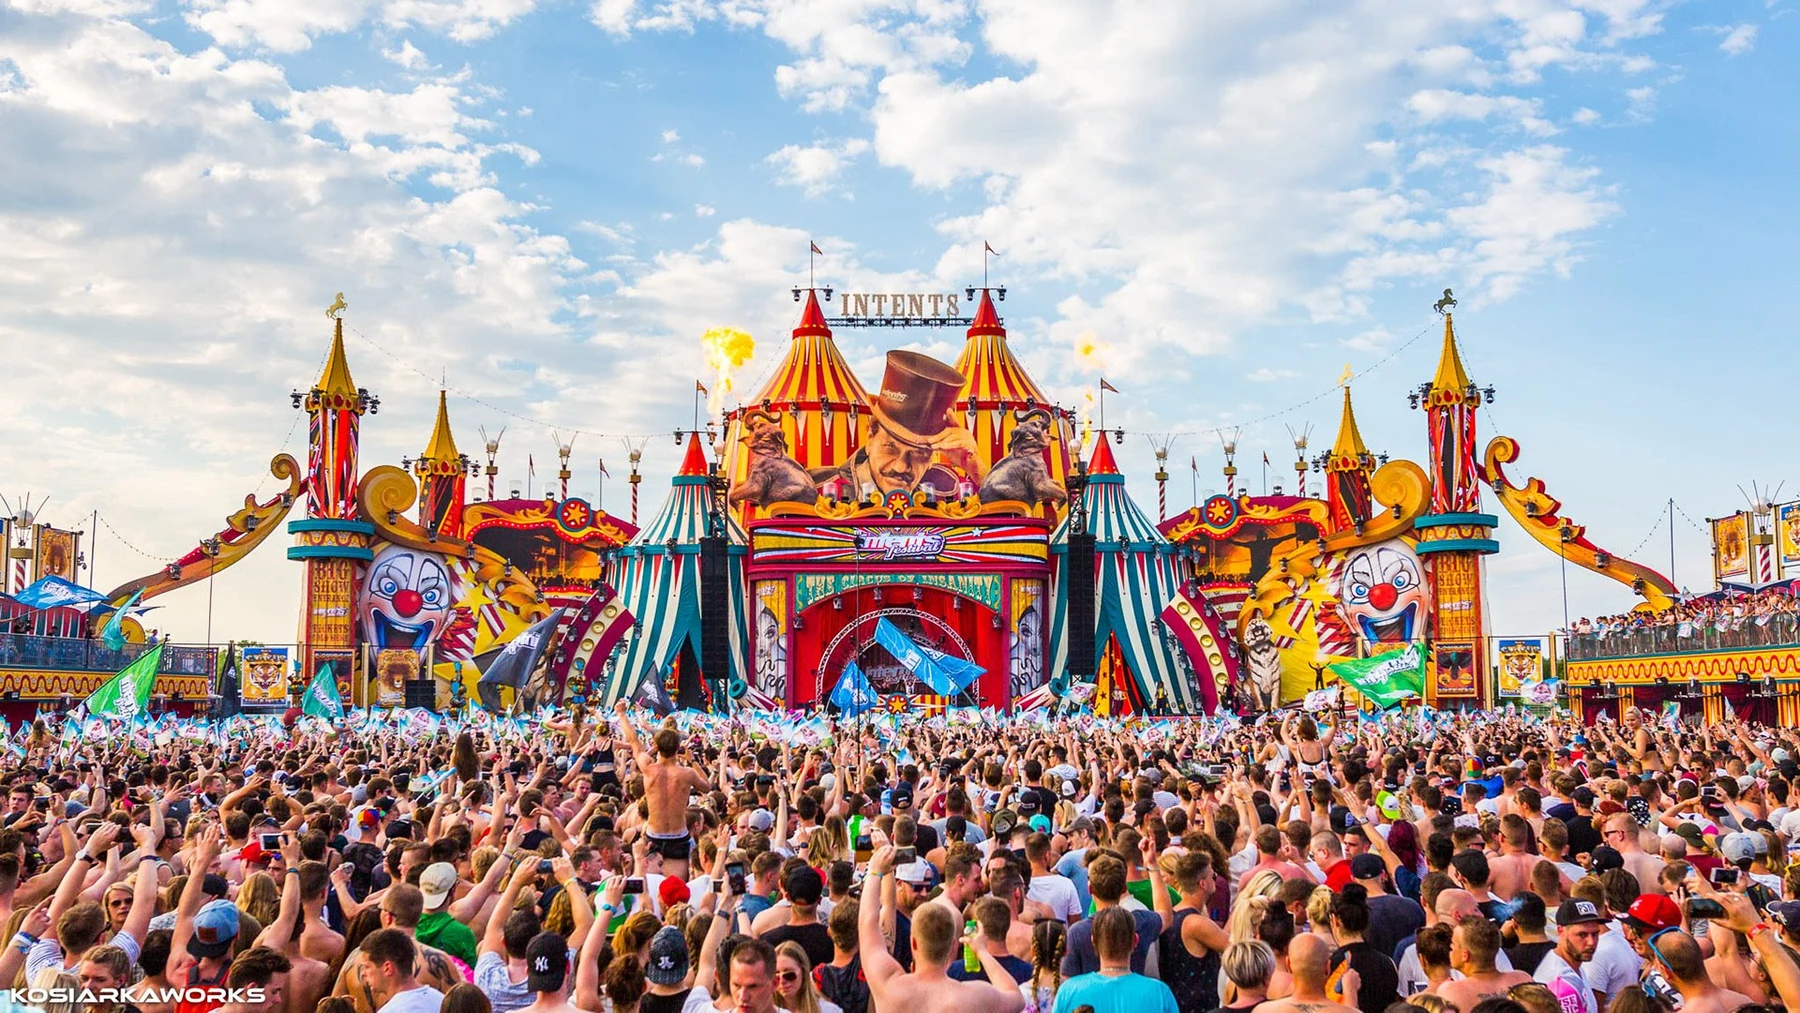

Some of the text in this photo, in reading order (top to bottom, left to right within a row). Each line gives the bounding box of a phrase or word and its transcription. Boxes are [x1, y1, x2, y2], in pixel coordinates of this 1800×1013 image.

[841, 293, 960, 317] INTENTS
[884, 543, 940, 560] festival
[314, 560, 350, 580] BIG
[313, 580, 350, 594] SHOW
[805, 575, 835, 605] THE
[841, 574, 891, 590] CIRCUS
[921, 575, 993, 605] INSANITY
